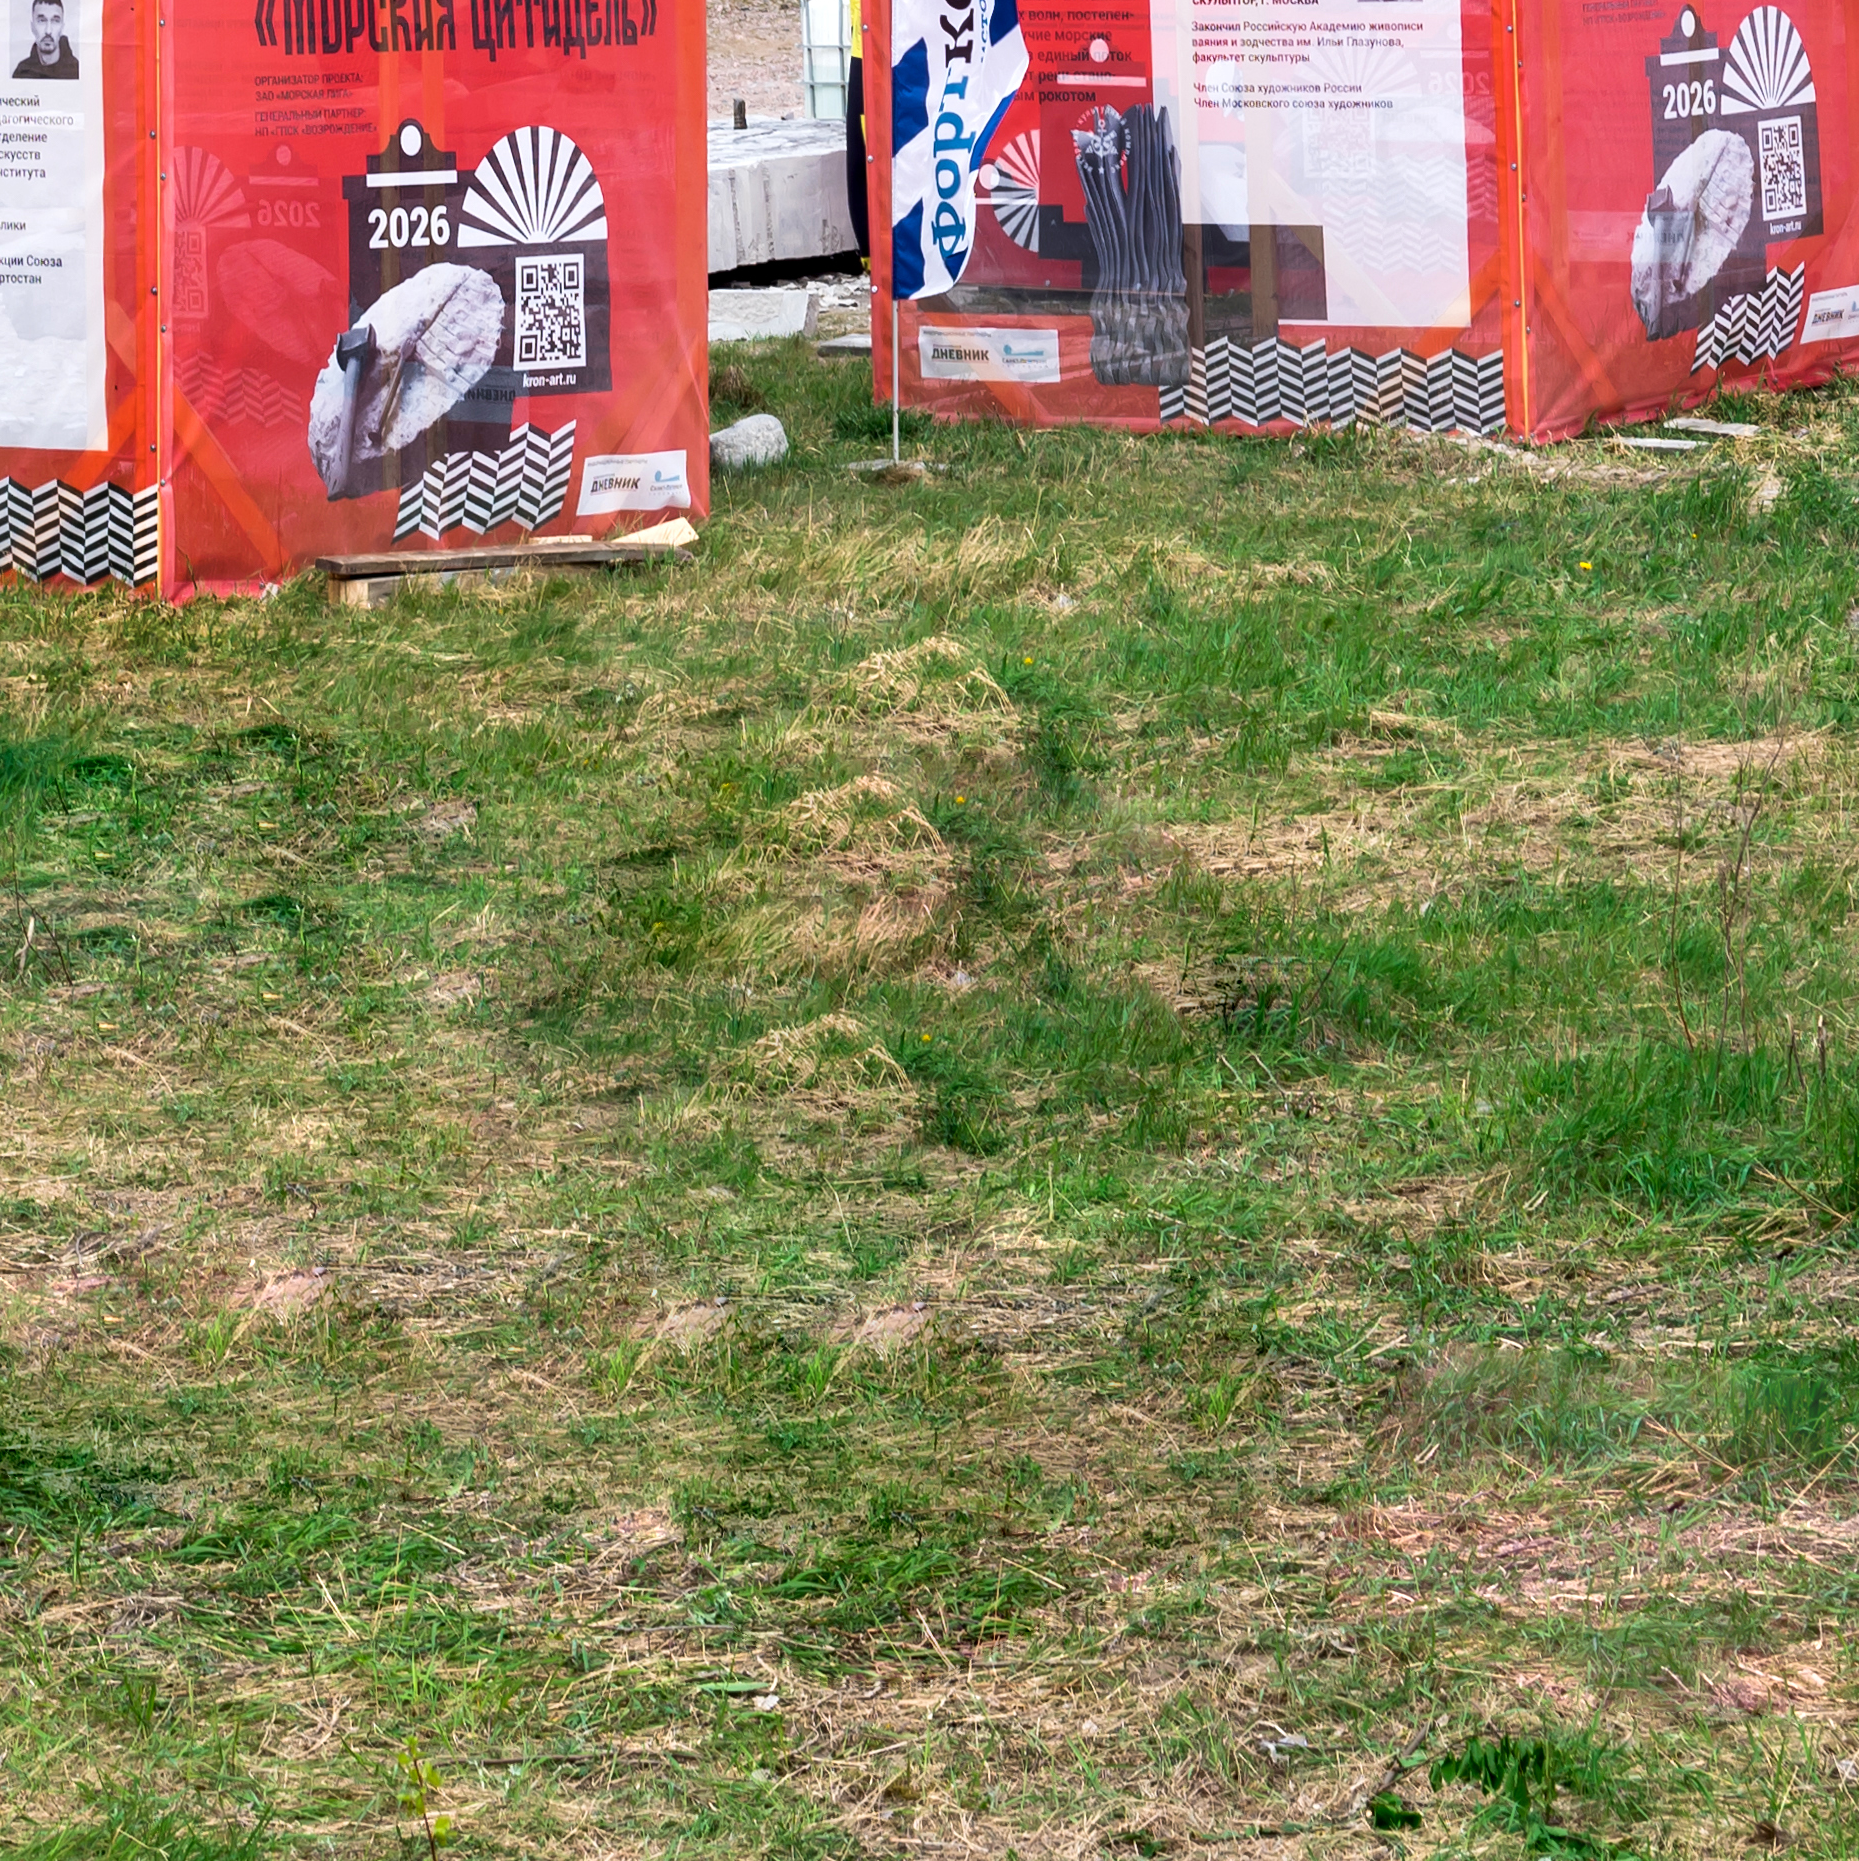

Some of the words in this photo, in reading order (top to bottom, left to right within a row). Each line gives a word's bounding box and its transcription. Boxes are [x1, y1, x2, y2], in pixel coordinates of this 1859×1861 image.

[1192, 21, 1241, 32] Закончил
[1244, 21, 1307, 34] Российскую
[1310, 21, 1366, 33] Академию
[1369, 22, 1423, 33] живописи
[1241, 37, 1294, 49] зодчества
[1346, 37, 1404, 50] Глазунова,
[1193, 51, 1245, 64] факультет
[1249, 53, 1310, 64] скульптуры
[255, 75, 319, 86] ОРГАНИЗАТОР
[1258, 83, 1321, 96] художников
[1324, 83, 1362, 93] России
[1039, 92, 1096, 106] рокотом
[1222, 98, 1289, 110] Московского
[1328, 99, 1393, 111] художников
[1663, 78, 1716, 120] 2026
[368, 205, 450, 249] 2026
[1770, 218, 1802, 235] kron-art.ru
[27, 256, 62, 268] Союза
[932, 348, 989, 360] ДНЕВНИК
[523, 371, 577, 389] kron-art.ru
[591, 476, 641, 493] ДНЕВНИК
